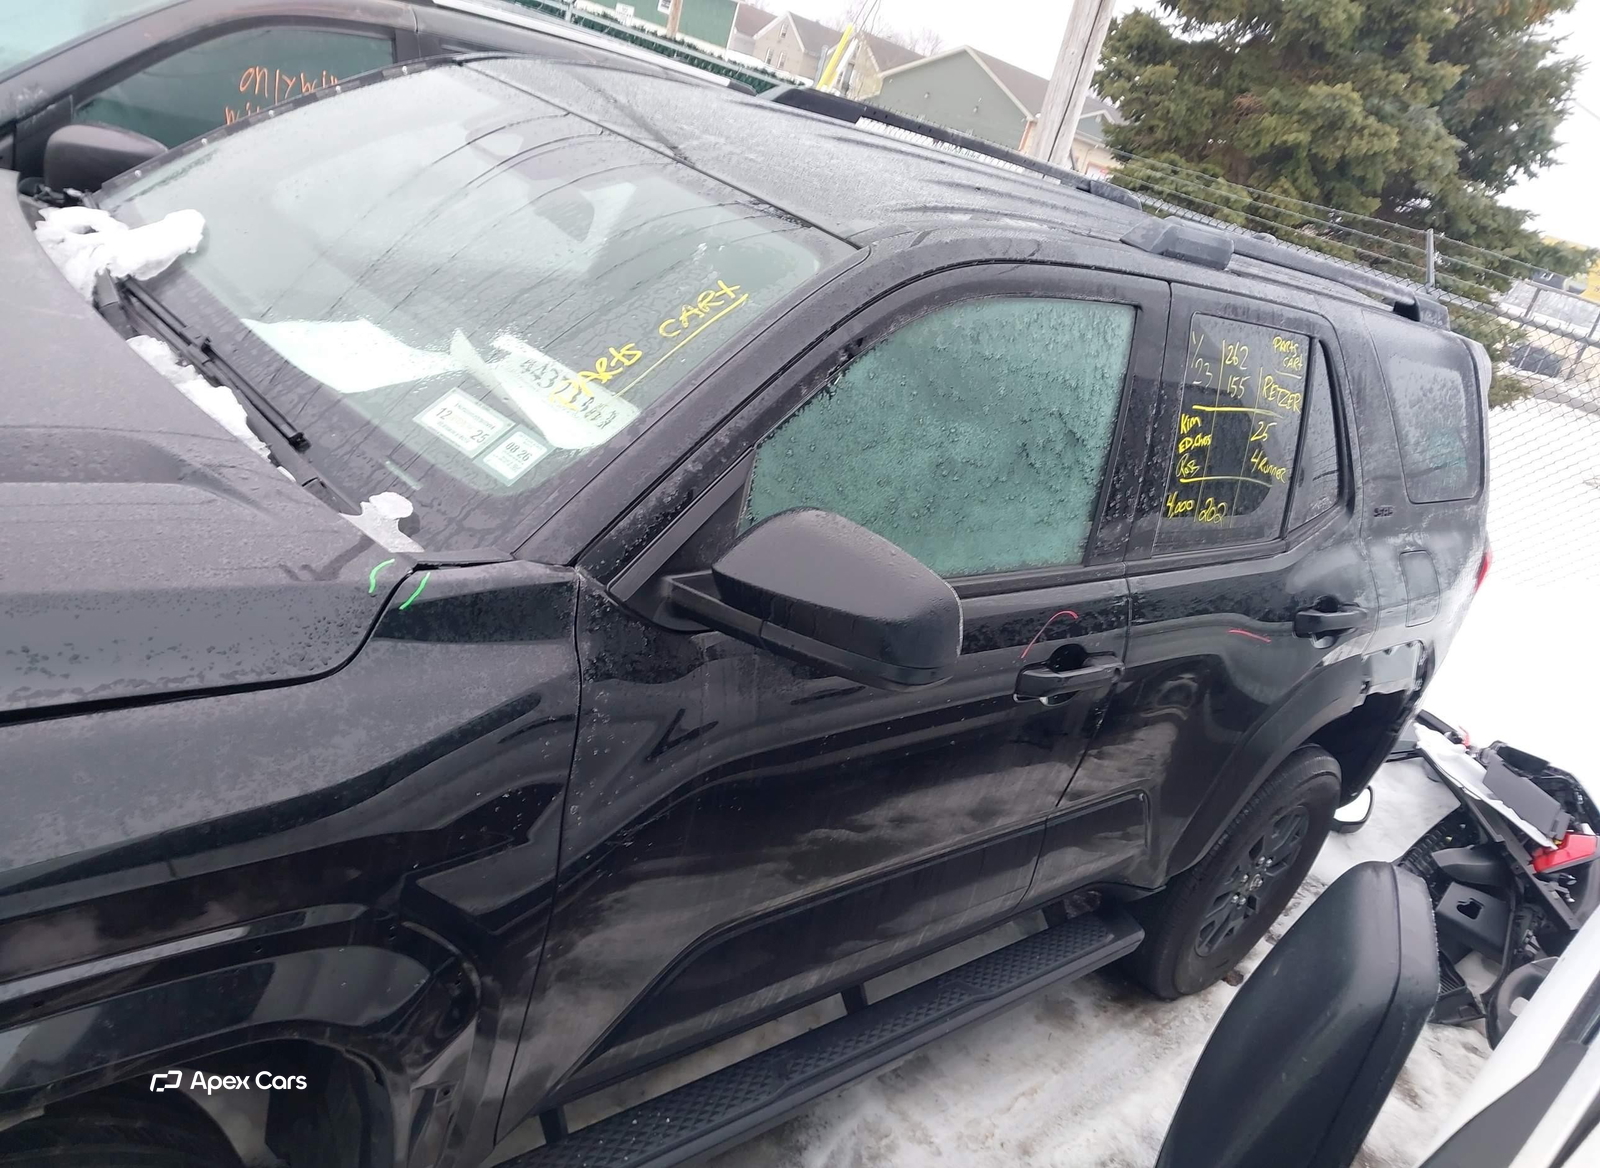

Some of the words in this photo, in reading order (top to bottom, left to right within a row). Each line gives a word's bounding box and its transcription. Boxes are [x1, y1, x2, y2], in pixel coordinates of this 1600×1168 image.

[1225, 341, 1249, 370] 262
[1226, 376, 1250, 399] 155
[1261, 375, 1301, 414] RETZER
[435, 407, 453, 420] 12
[470, 429, 490, 443] 25
[1180, 413, 1202, 434] Kim
[1250, 421, 1278, 442] 25
[517, 449, 533, 462] 26
